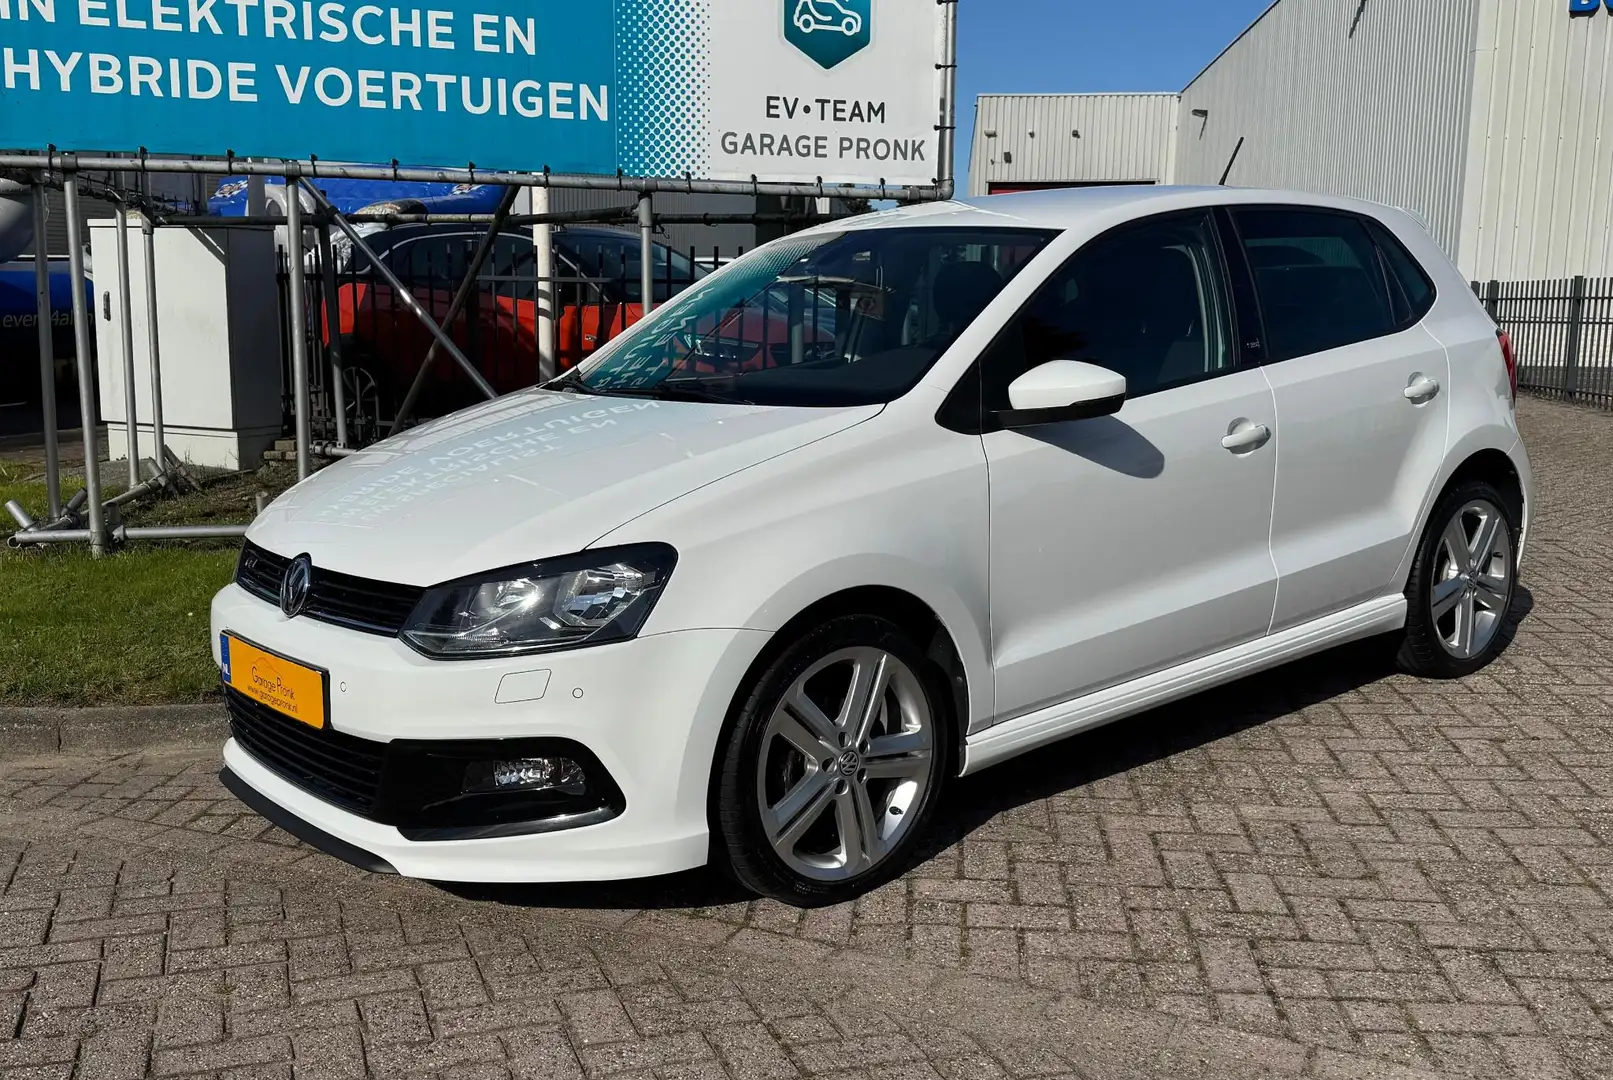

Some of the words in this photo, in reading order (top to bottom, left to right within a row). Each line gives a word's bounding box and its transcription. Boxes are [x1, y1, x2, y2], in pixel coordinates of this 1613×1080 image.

[78, 0, 455, 50] ELEKTRISCHE
[473, 13, 536, 55] EN
[3, 47, 258, 102] HYBRIDE
[275, 64, 609, 121] VOERTUIGEN
[720, 131, 828, 159] GARAGE
[838, 136, 926, 162] PRONK
[251, 666, 276, 694] Garage
[276, 676, 296, 701] Pronk
